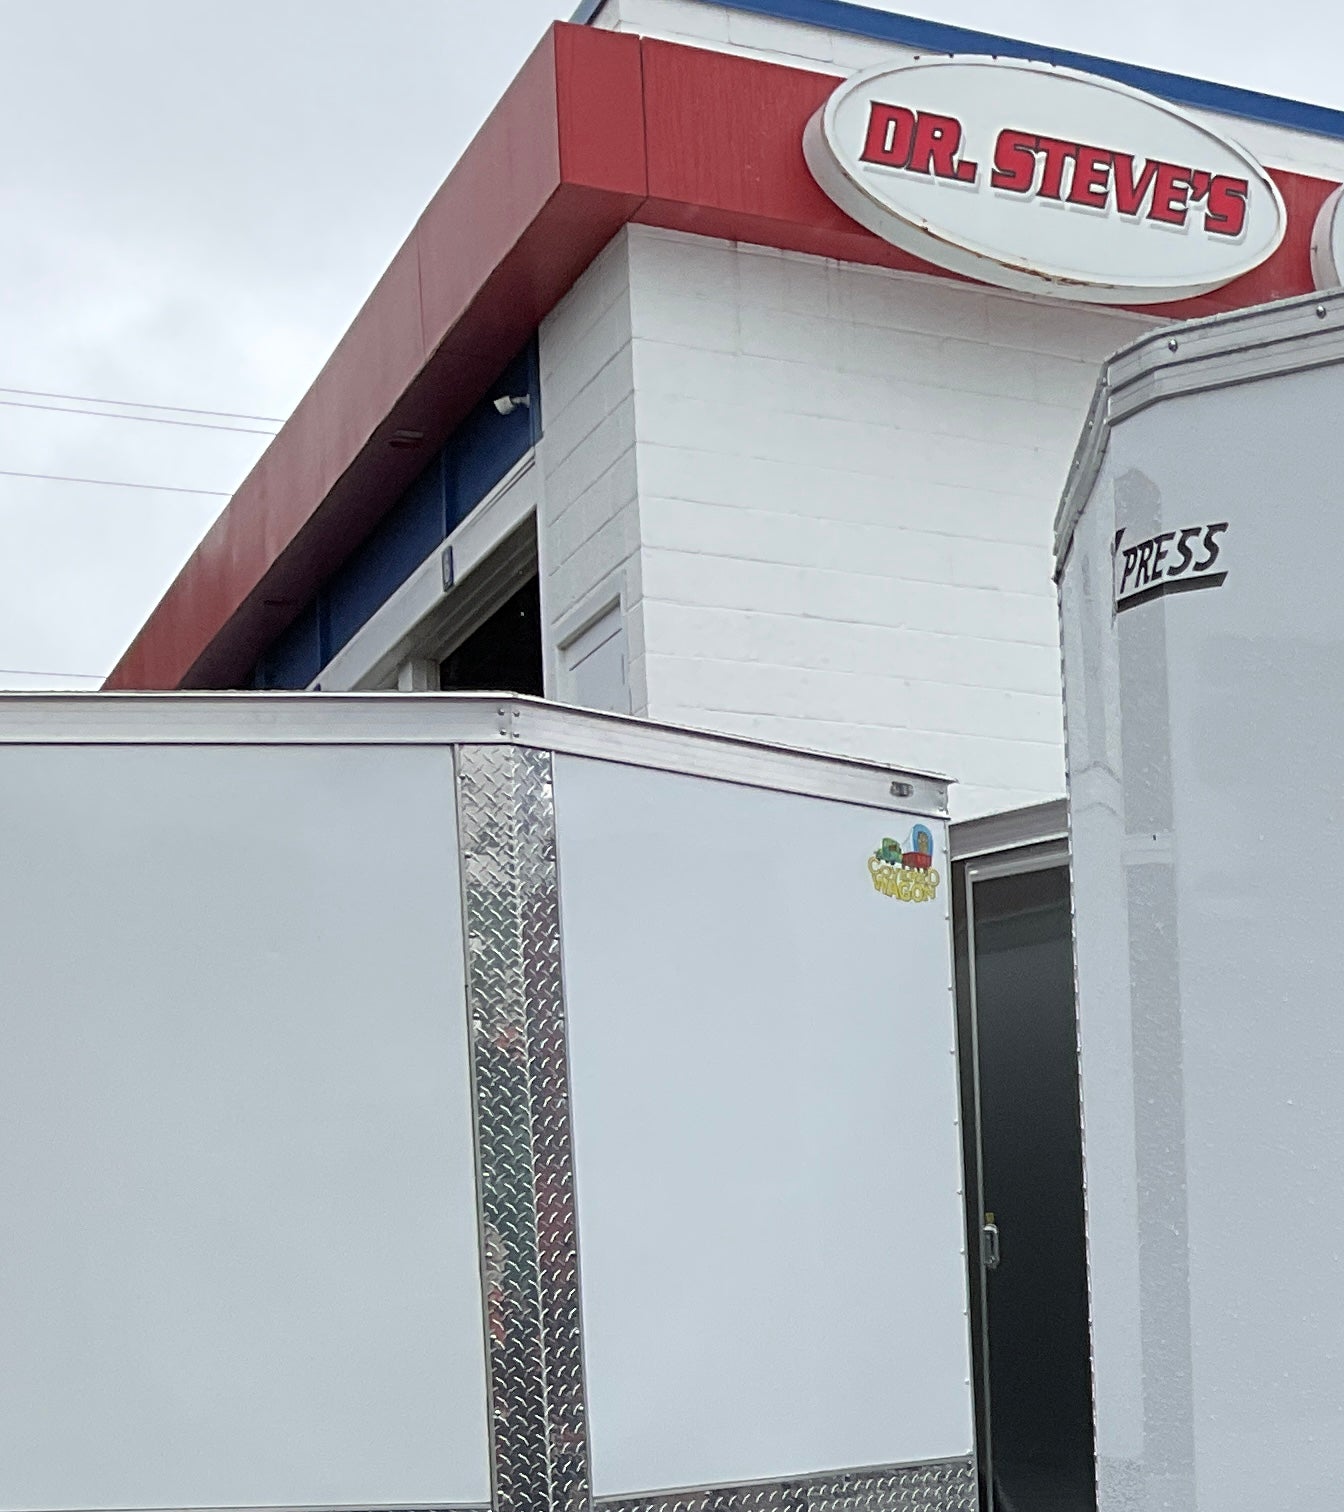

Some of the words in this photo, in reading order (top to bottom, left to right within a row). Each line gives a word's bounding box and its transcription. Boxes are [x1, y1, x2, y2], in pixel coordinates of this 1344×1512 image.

[858, 100, 979, 184] DR.
[990, 128, 1249, 237] STEVE'S
[1114, 521, 1229, 600] PRESS
